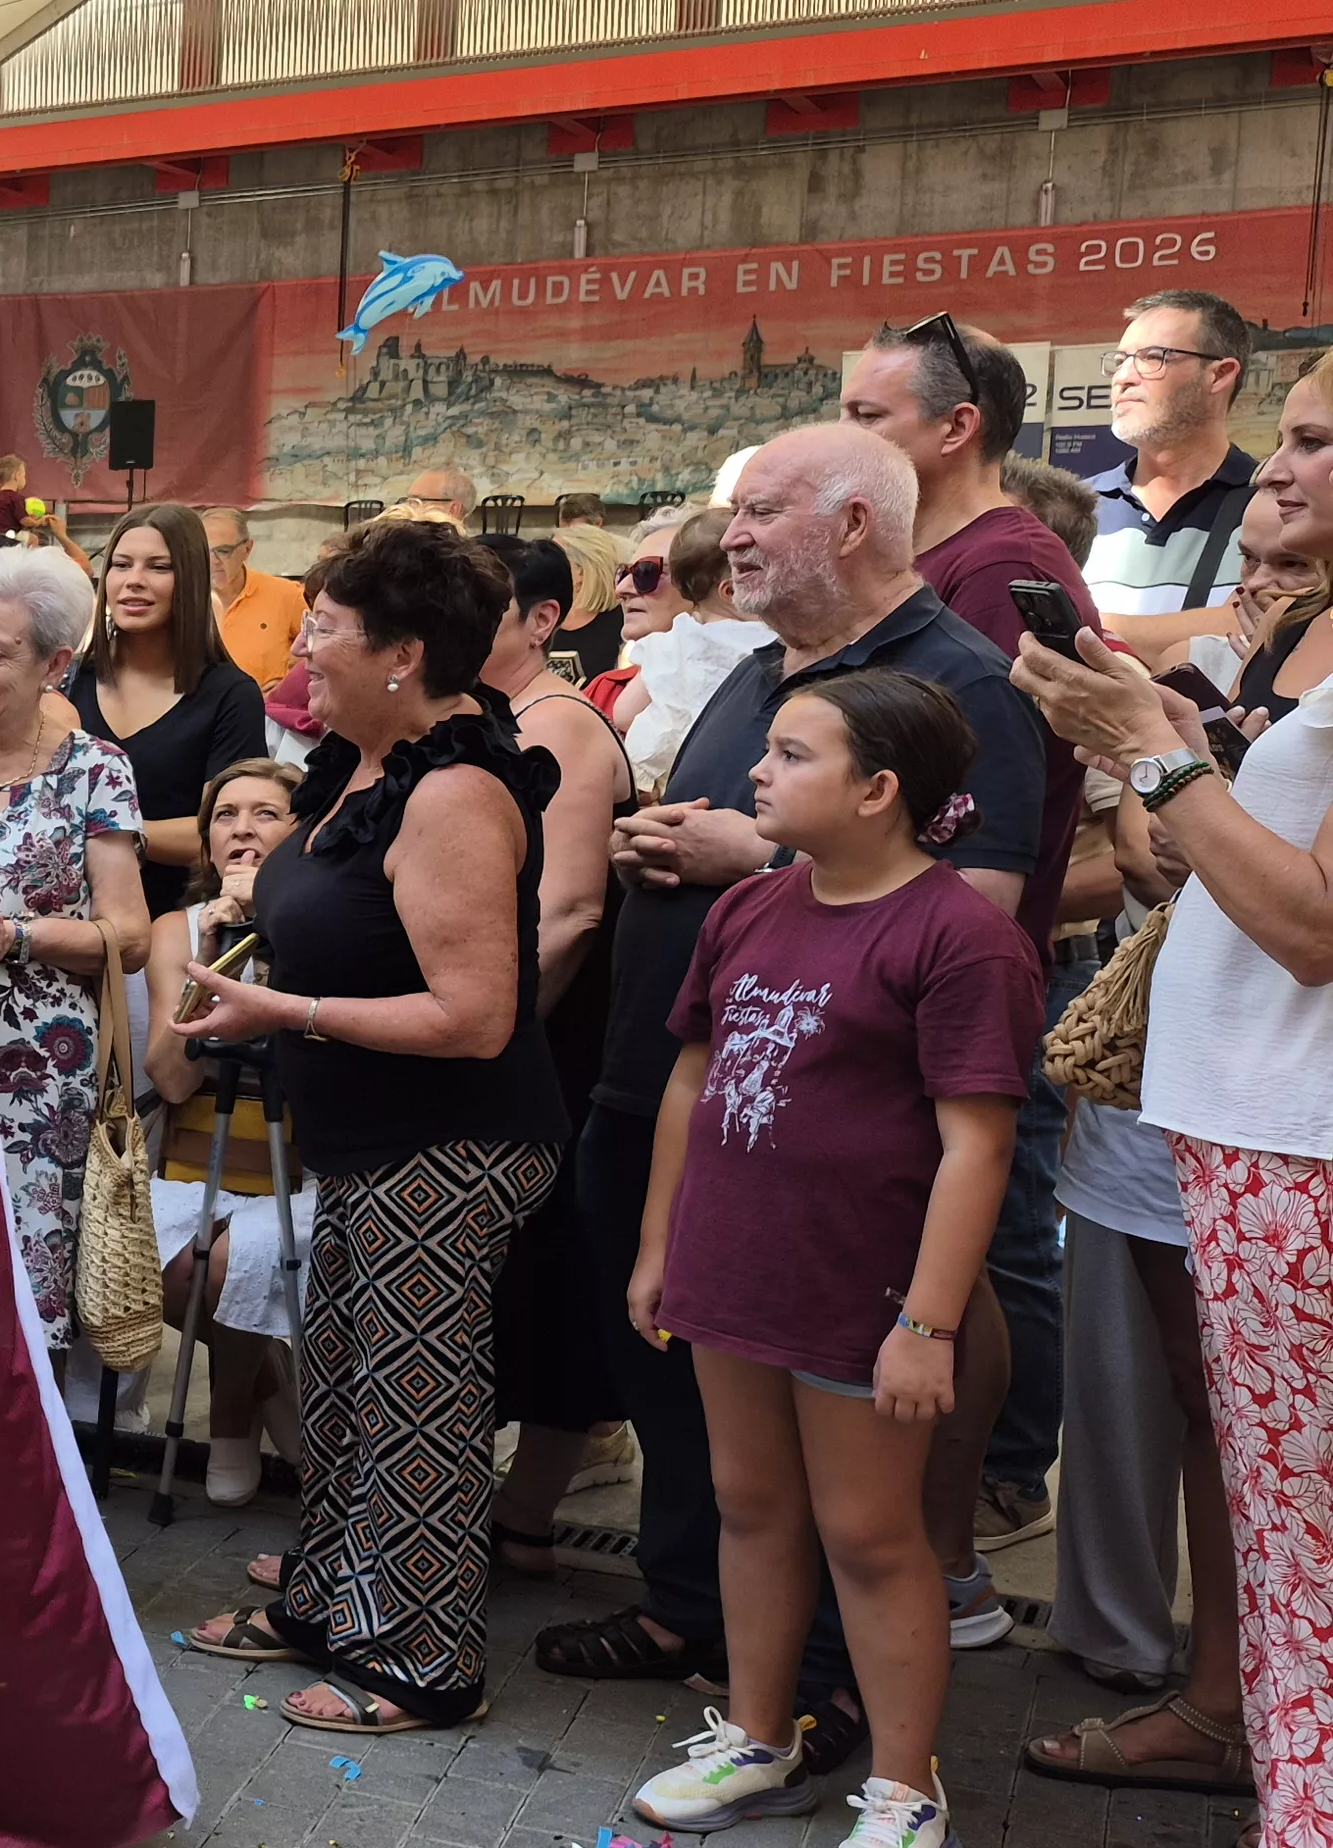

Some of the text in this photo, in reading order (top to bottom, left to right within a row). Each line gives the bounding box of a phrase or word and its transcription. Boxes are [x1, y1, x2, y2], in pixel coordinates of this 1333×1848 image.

[408, 231, 1216, 313] LMUDÉVAR EN FIESTAS 2026
[1057, 384, 1112, 411] SE
[729, 972, 833, 1008] Almudévar
[720, 1004, 764, 1027] Fiestas
